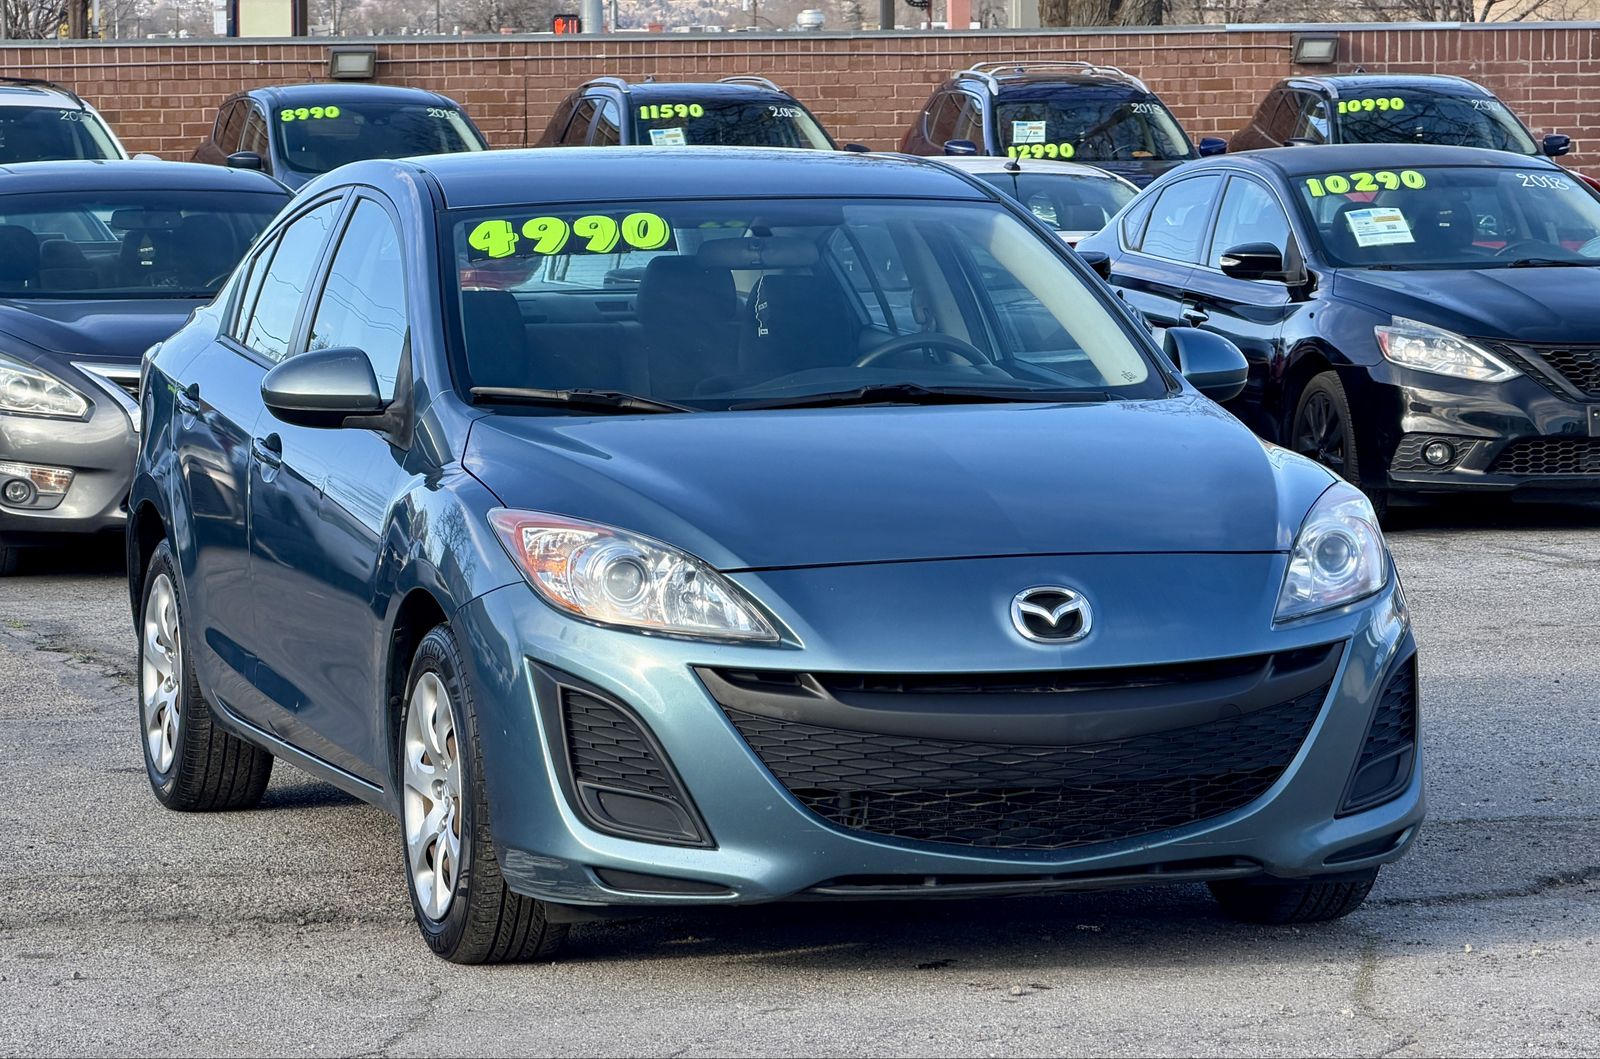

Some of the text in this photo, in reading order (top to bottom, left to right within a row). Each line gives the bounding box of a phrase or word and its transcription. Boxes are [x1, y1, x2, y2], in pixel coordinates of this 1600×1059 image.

[640, 104, 704, 119] 11590
[1338, 98, 1405, 113] 10990
[59, 110, 93, 122] 2017
[280, 106, 340, 121] 8990
[1008, 143, 1075, 159] 12990
[1306, 170, 1426, 197] 10290
[1515, 173, 1569, 191] 2018
[469, 212, 670, 259] 4990
